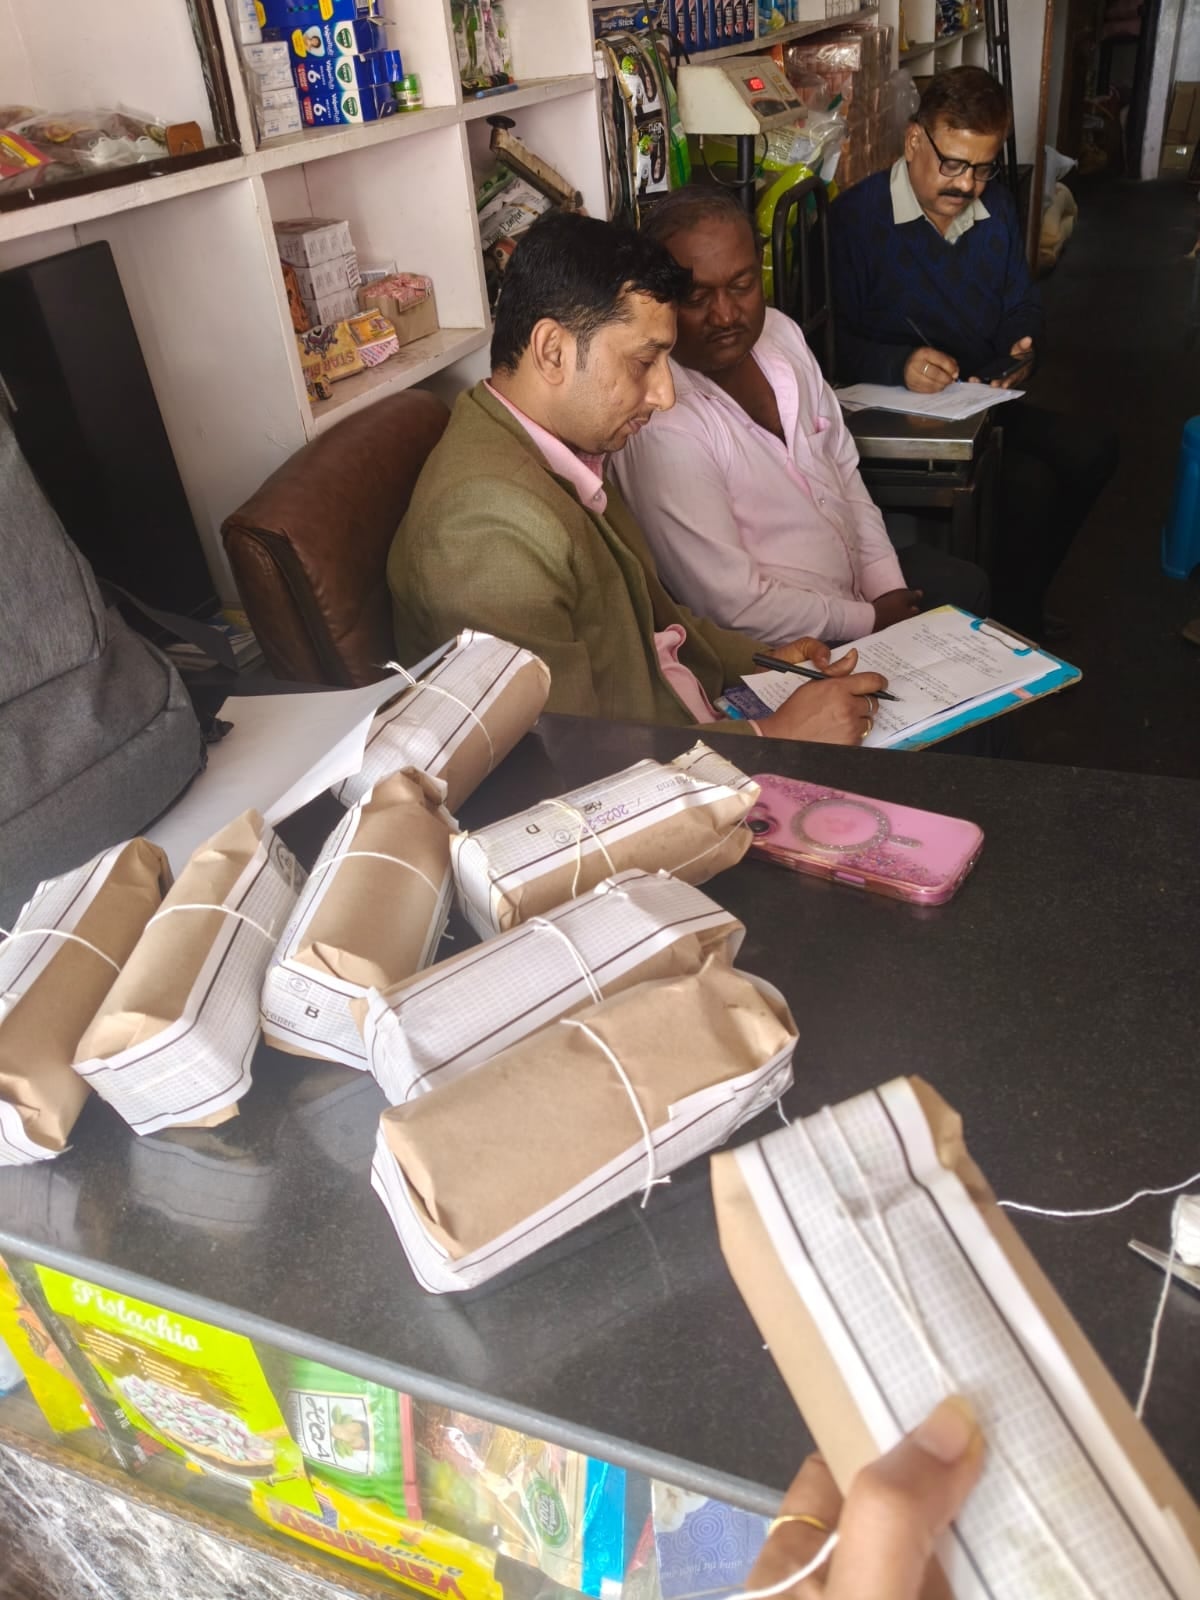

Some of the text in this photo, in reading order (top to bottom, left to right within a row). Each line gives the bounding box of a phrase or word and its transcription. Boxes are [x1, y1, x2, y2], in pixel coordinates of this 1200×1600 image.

[324, 25, 334, 56] VapoRub
[307, 69, 321, 83] 6
[326, 60, 335, 90] VapoRub
[313, 103, 327, 116] 6
[331, 93, 341, 123] VapoRub
[71, 1280, 202, 1351] Pistachio
